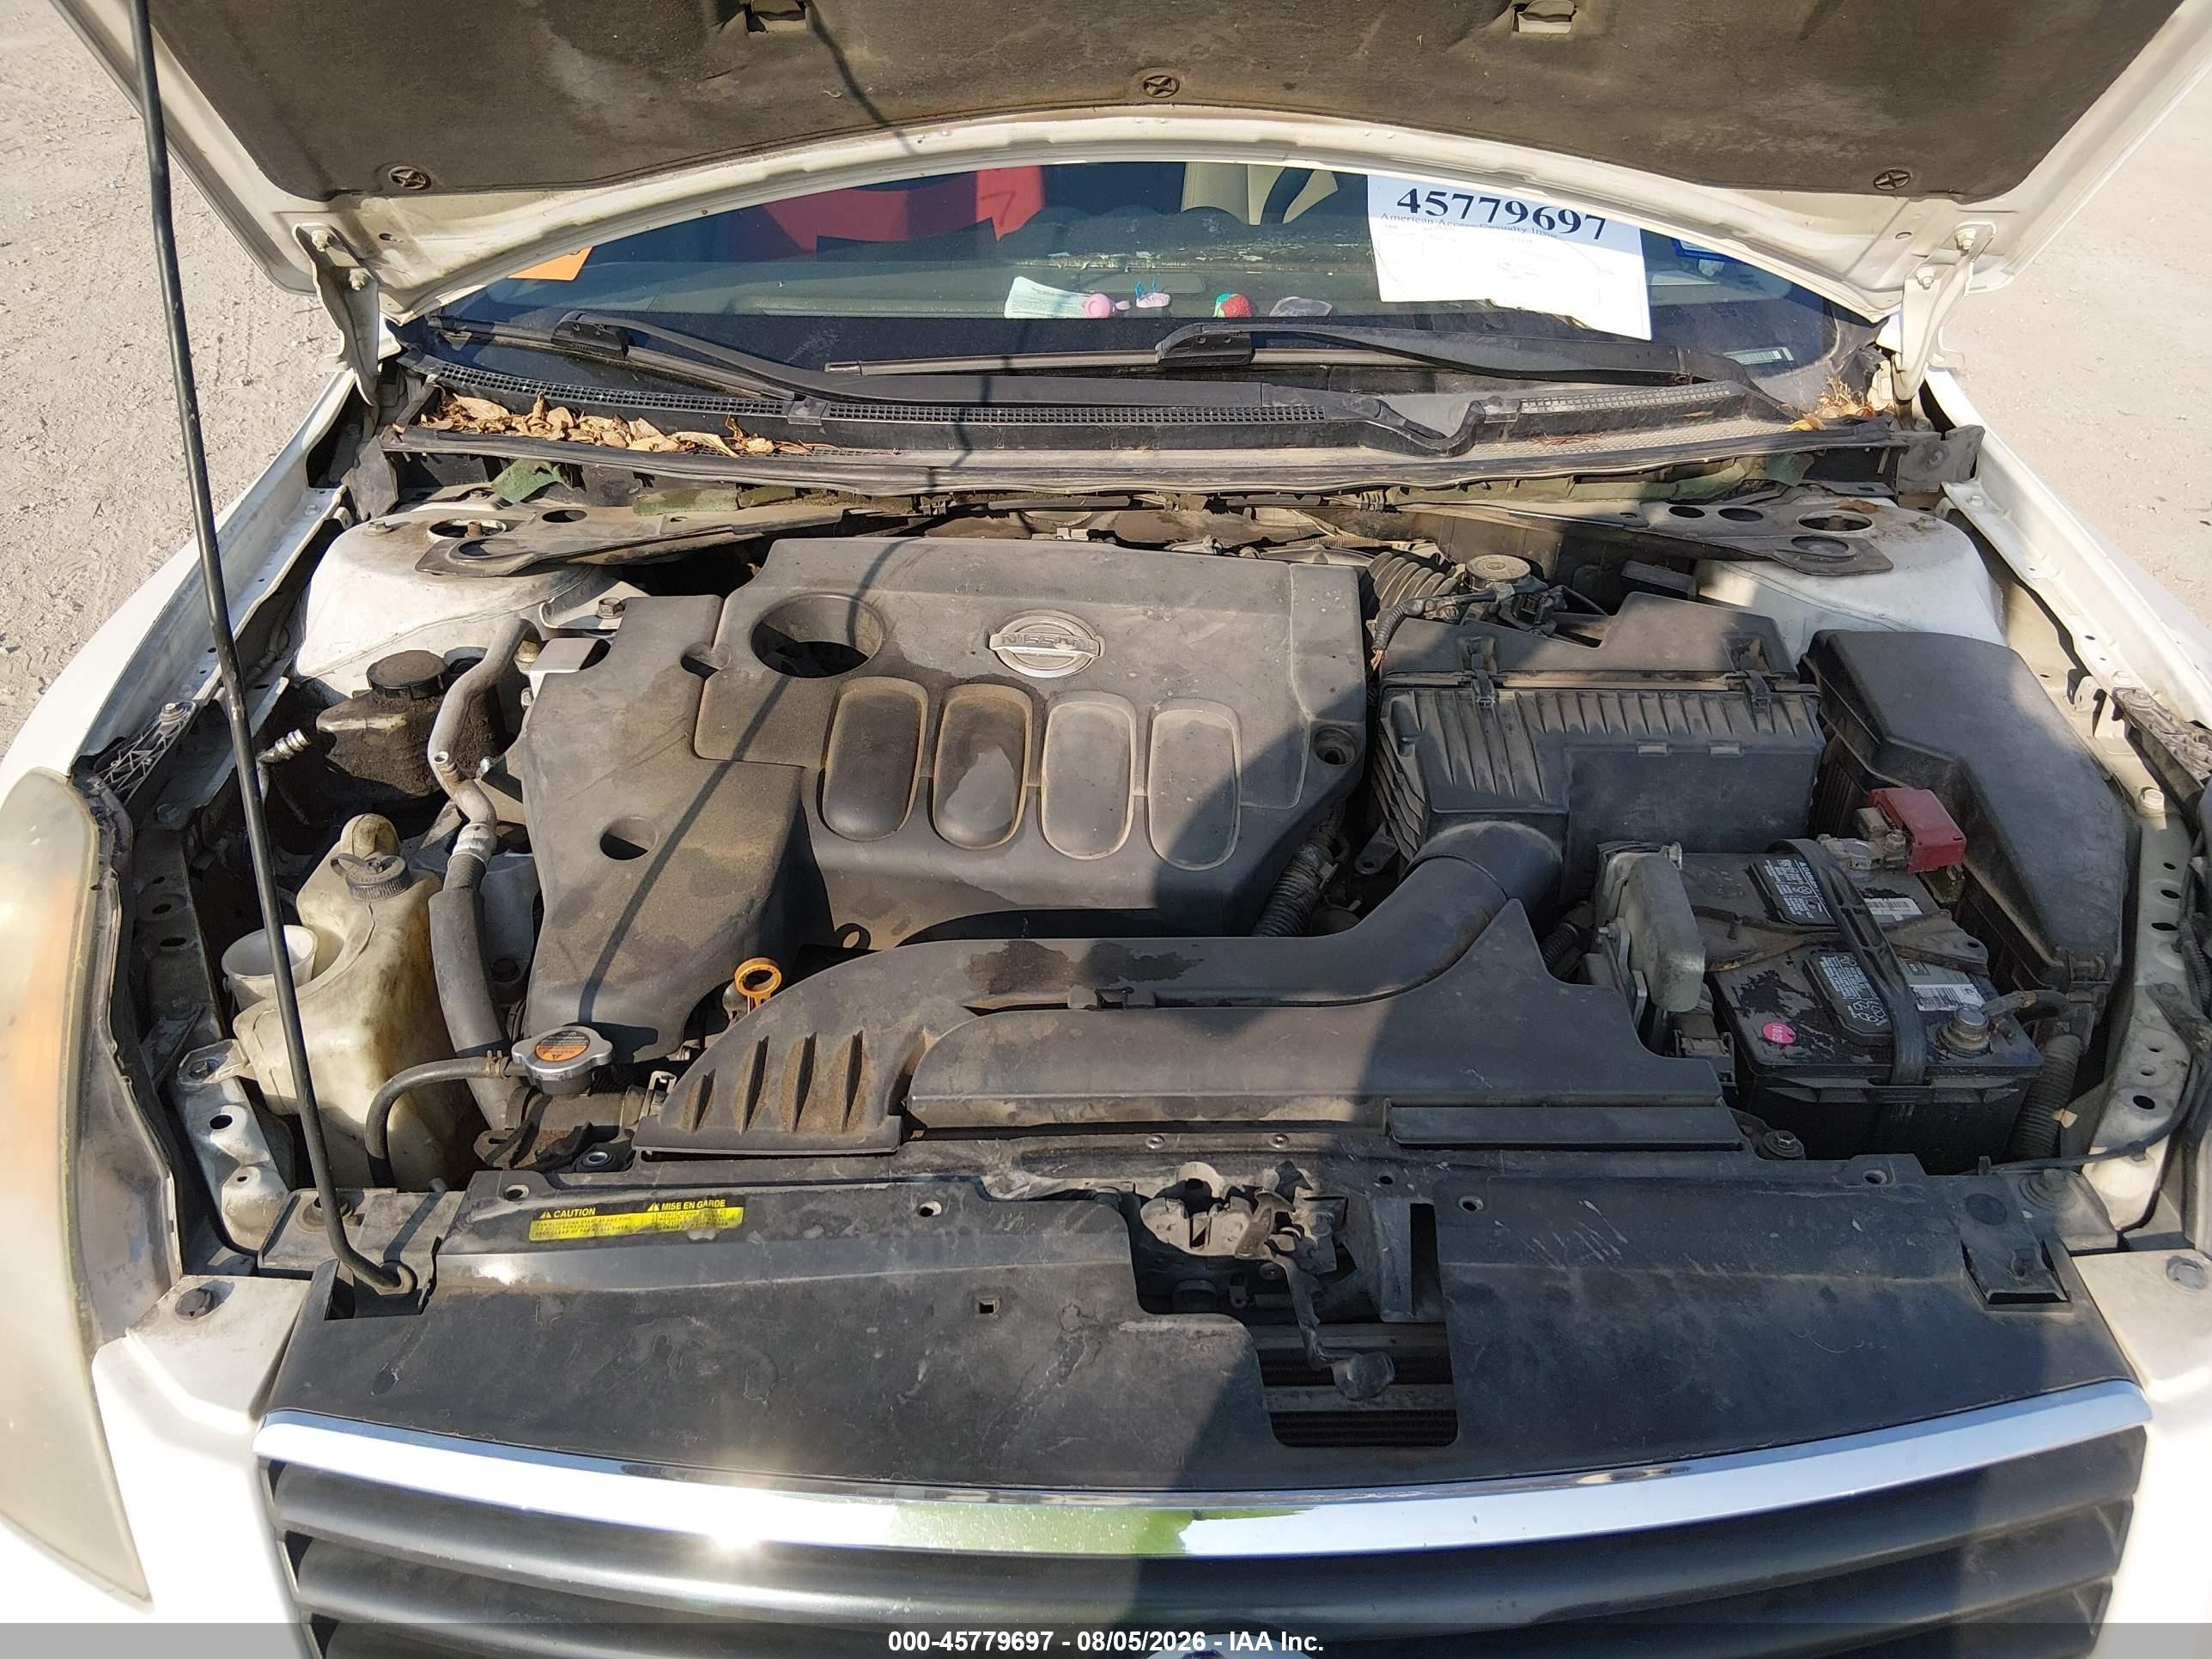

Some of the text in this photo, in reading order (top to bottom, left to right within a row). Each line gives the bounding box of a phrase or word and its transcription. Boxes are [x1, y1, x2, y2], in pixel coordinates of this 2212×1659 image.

[1380, 212, 1434, 225] American
[1396, 187, 1607, 240] 45779697
[661, 1199, 726, 1211] MISE EN GARDE
[553, 1207, 596, 1218] CAUTION
